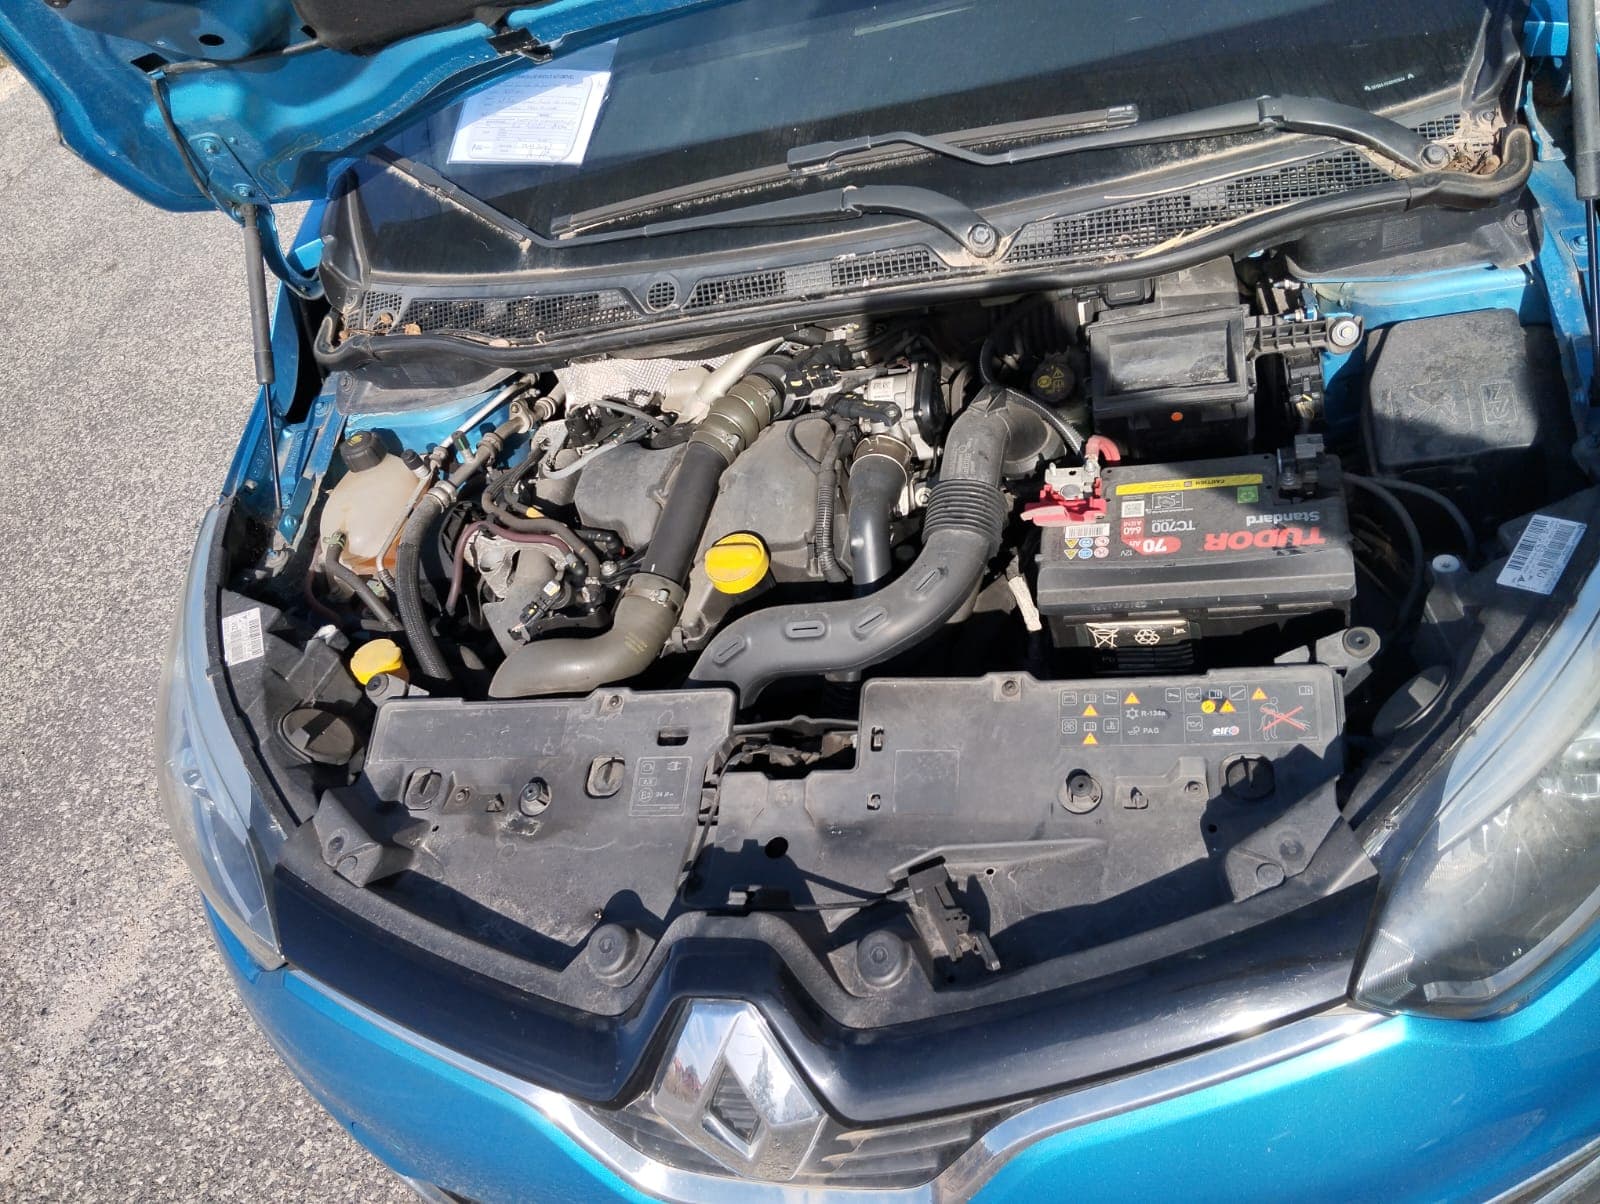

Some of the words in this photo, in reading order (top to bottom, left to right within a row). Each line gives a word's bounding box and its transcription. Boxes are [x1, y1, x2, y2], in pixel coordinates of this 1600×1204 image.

[1246, 511, 1320, 527] Standard
[1123, 527, 1142, 535] 640
[1151, 520, 1196, 533] TC700
[1204, 527, 1326, 551] TUDOR
[1143, 539, 1167, 553] 70
[1120, 549, 1133, 557] 12V
[1212, 727, 1230, 736] elf
